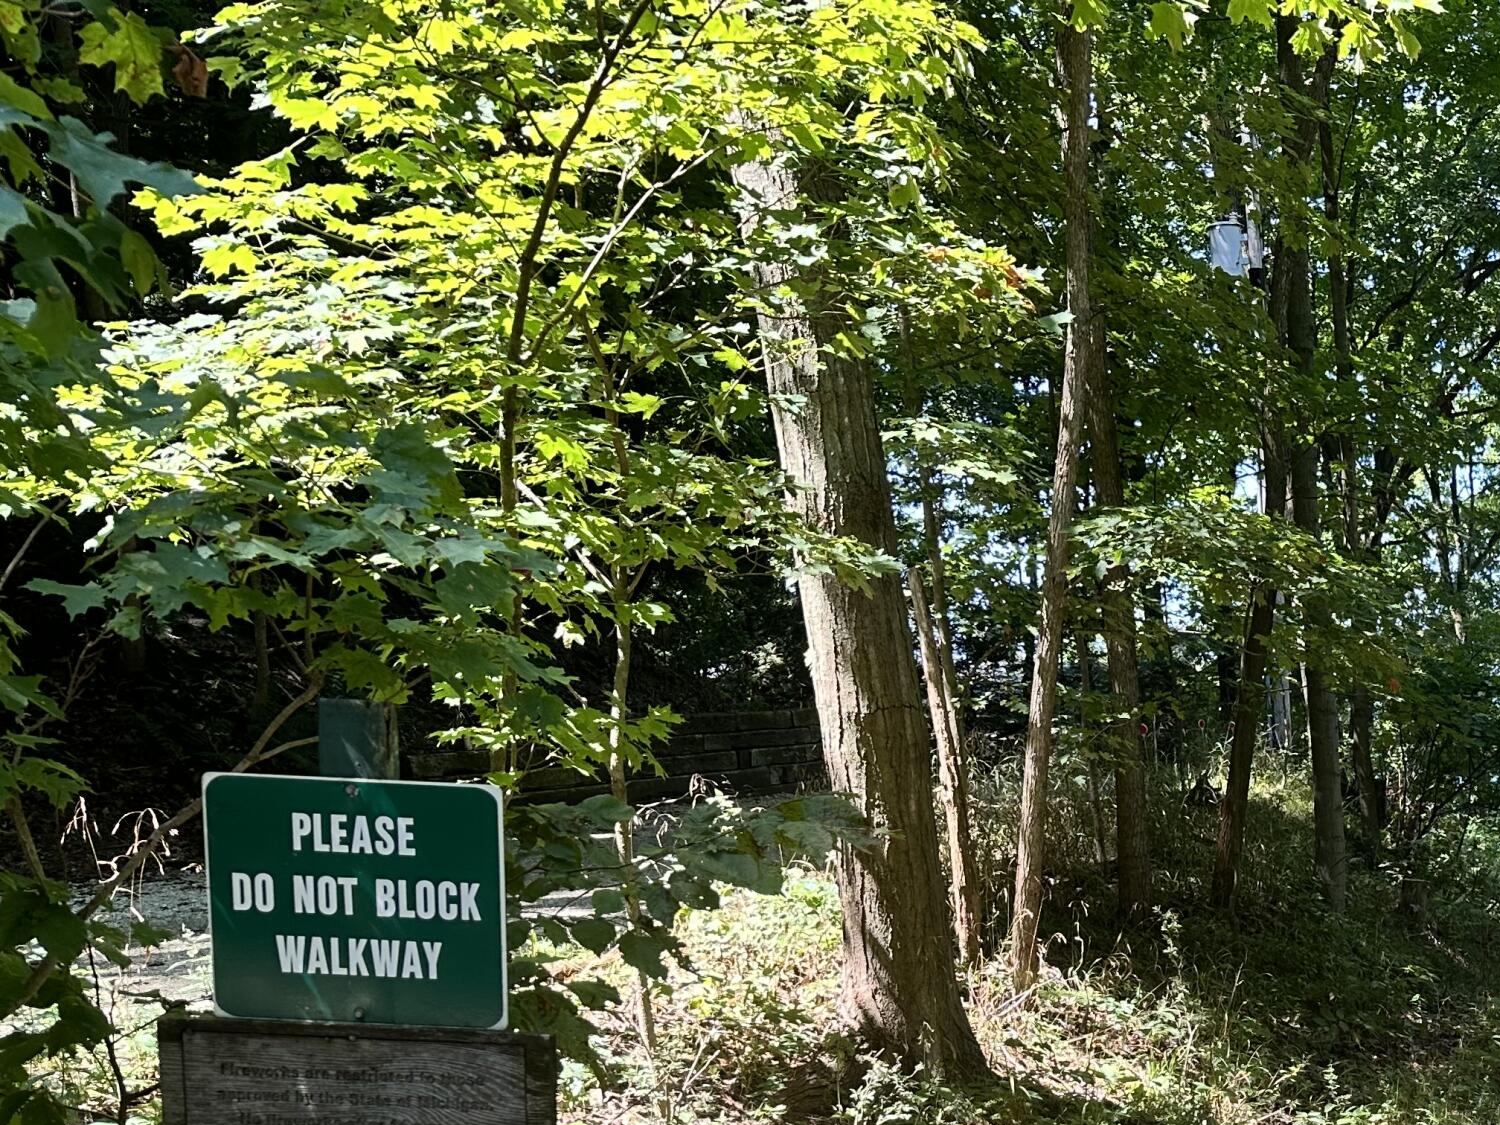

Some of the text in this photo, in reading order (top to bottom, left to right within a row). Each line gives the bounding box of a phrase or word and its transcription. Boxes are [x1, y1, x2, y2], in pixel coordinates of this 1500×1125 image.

[291, 812, 416, 856] PLEASE
[231, 872, 482, 921] DO NOT BLOCK
[275, 934, 442, 980] WALKWAY
[305, 1066, 329, 1080] are
[295, 1090, 314, 1106] by
[319, 1091, 343, 1104] the
